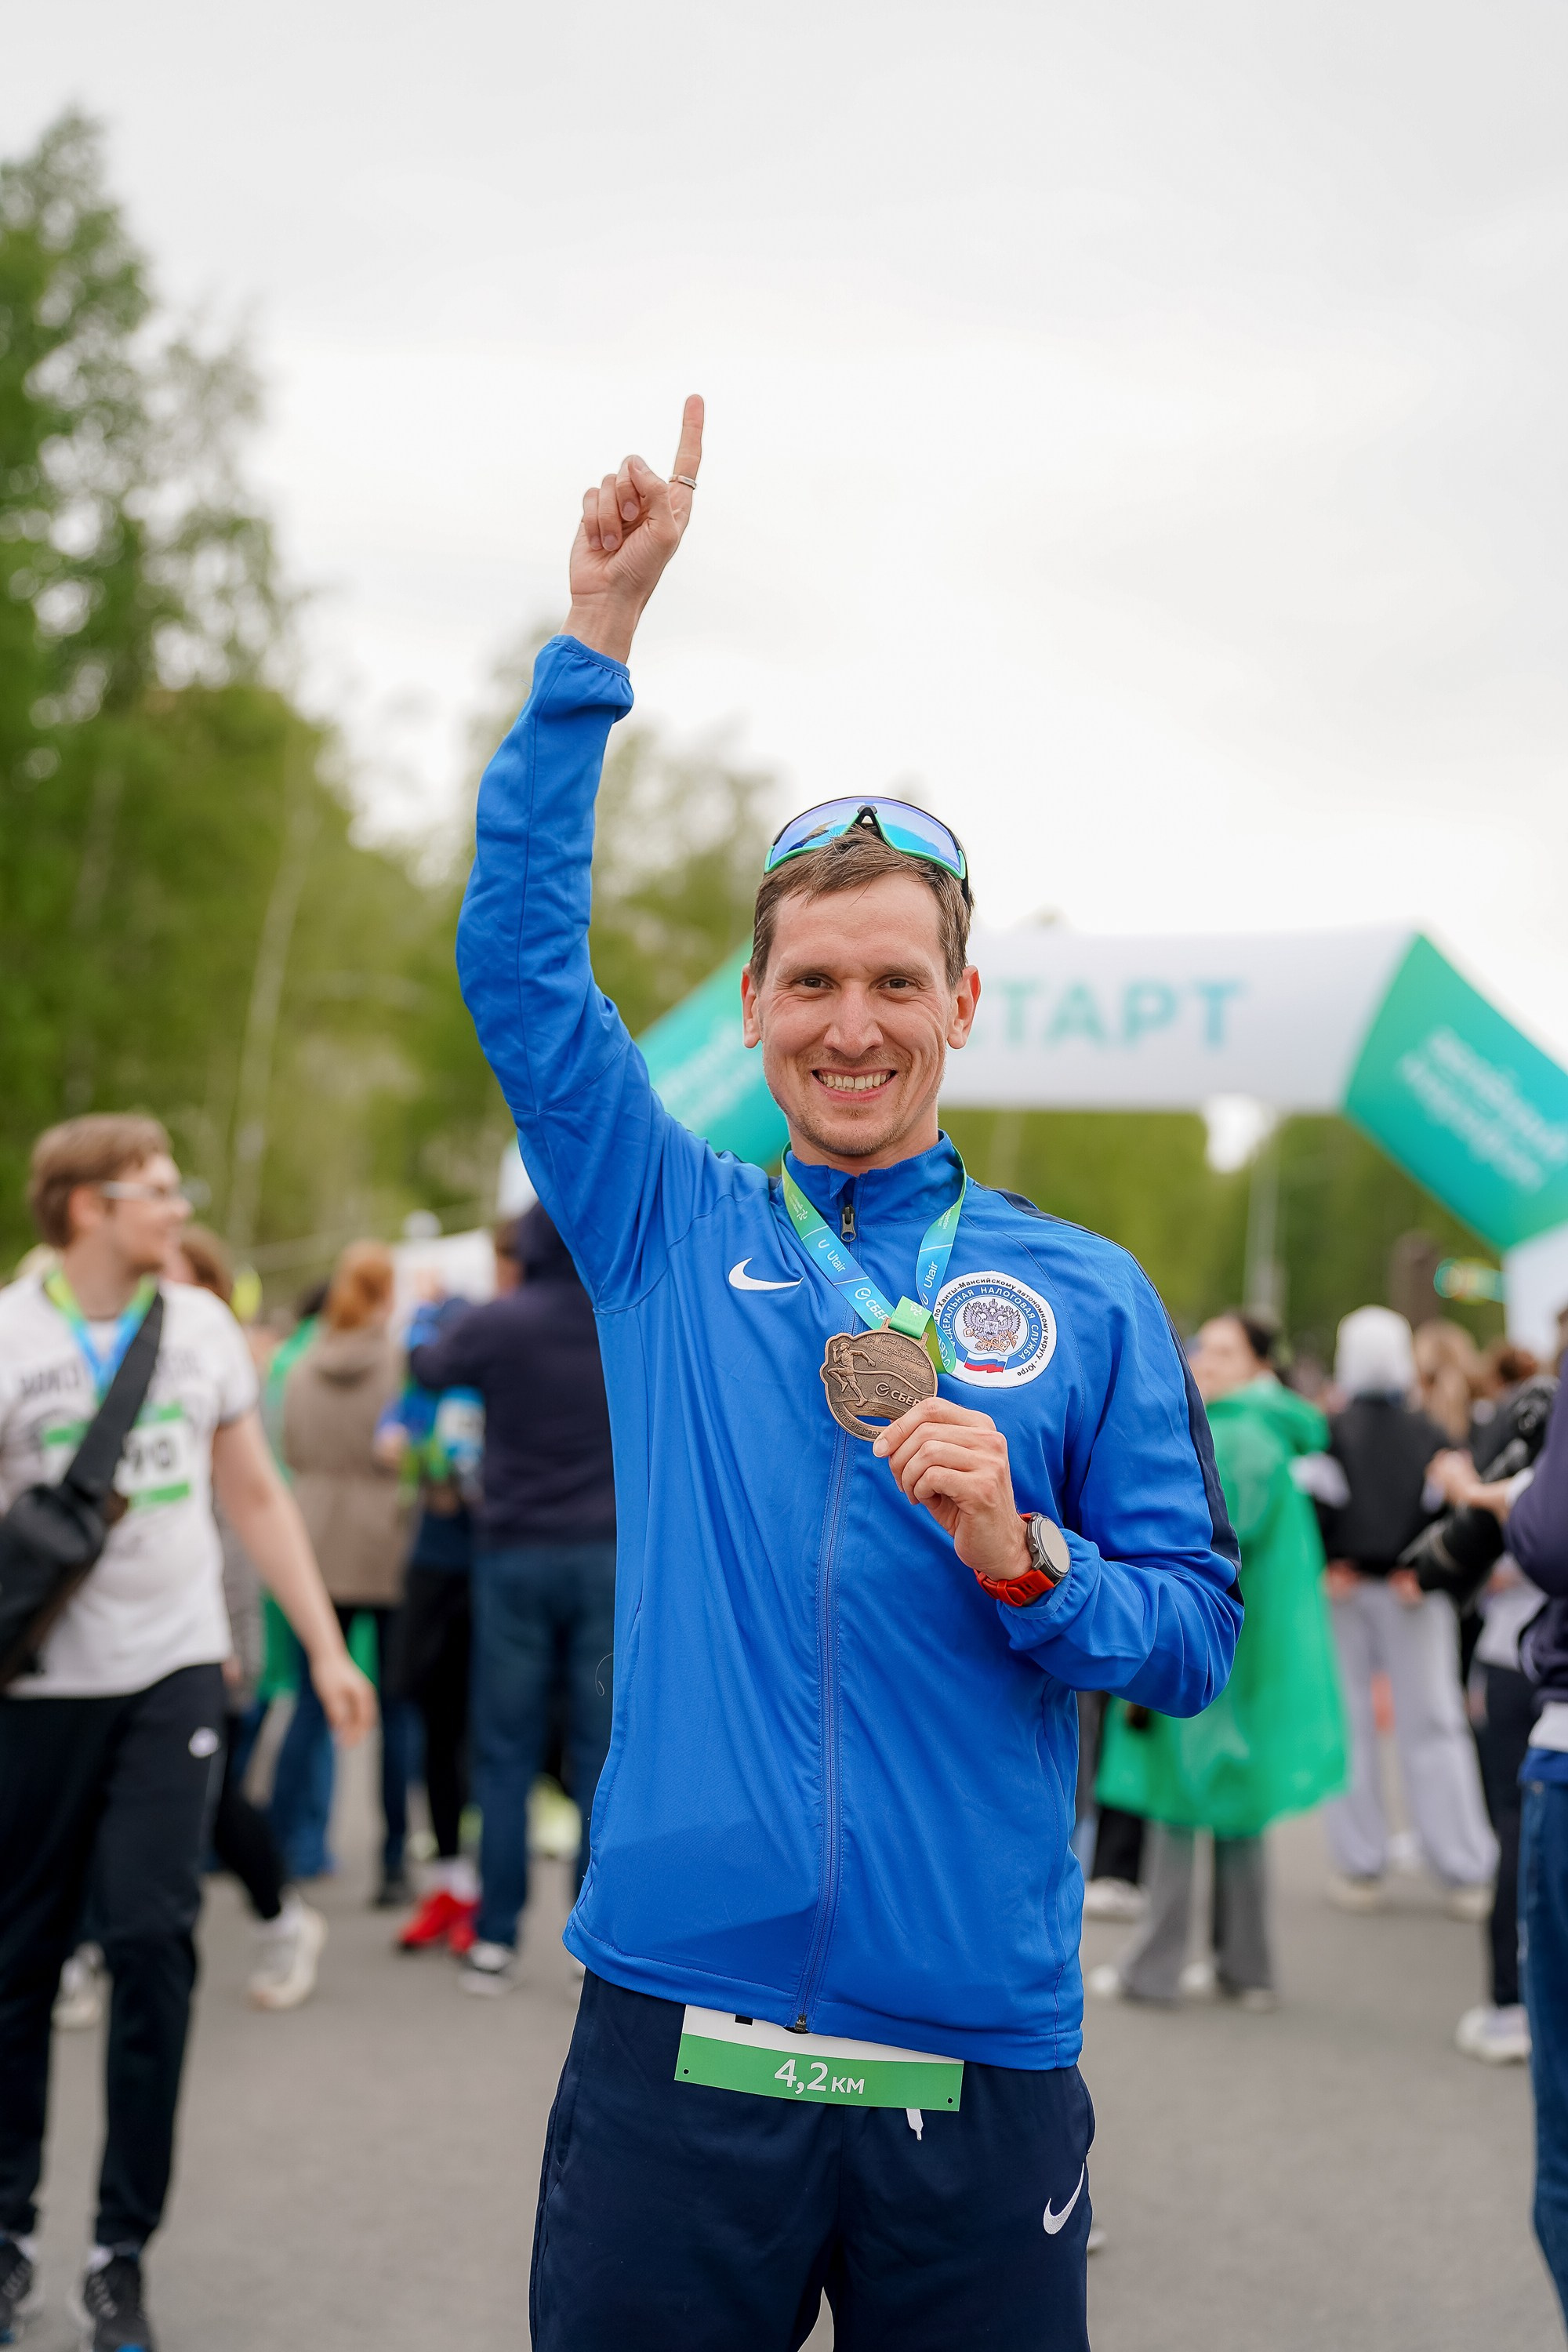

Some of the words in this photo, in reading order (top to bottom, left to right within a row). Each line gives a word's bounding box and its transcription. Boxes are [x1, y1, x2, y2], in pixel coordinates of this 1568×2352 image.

[971, 977, 1244, 1052] ТАРТ
[826, 1250, 846, 1272] Utair
[923, 1261, 938, 1288] Utair
[936, 1278, 1016, 1308] Ханты-Мансийскому
[935, 1308, 941, 1318] по
[980, 1287, 1036, 1319] НАЛОГОВАЯ
[1018, 1324, 1039, 1360] СЛУЖБА
[1017, 1289, 1049, 1333] автономному
[1036, 1335, 1049, 1361] округу
[1017, 1363, 1036, 1377] Югре
[891, 1389, 921, 1406] СБЕР
